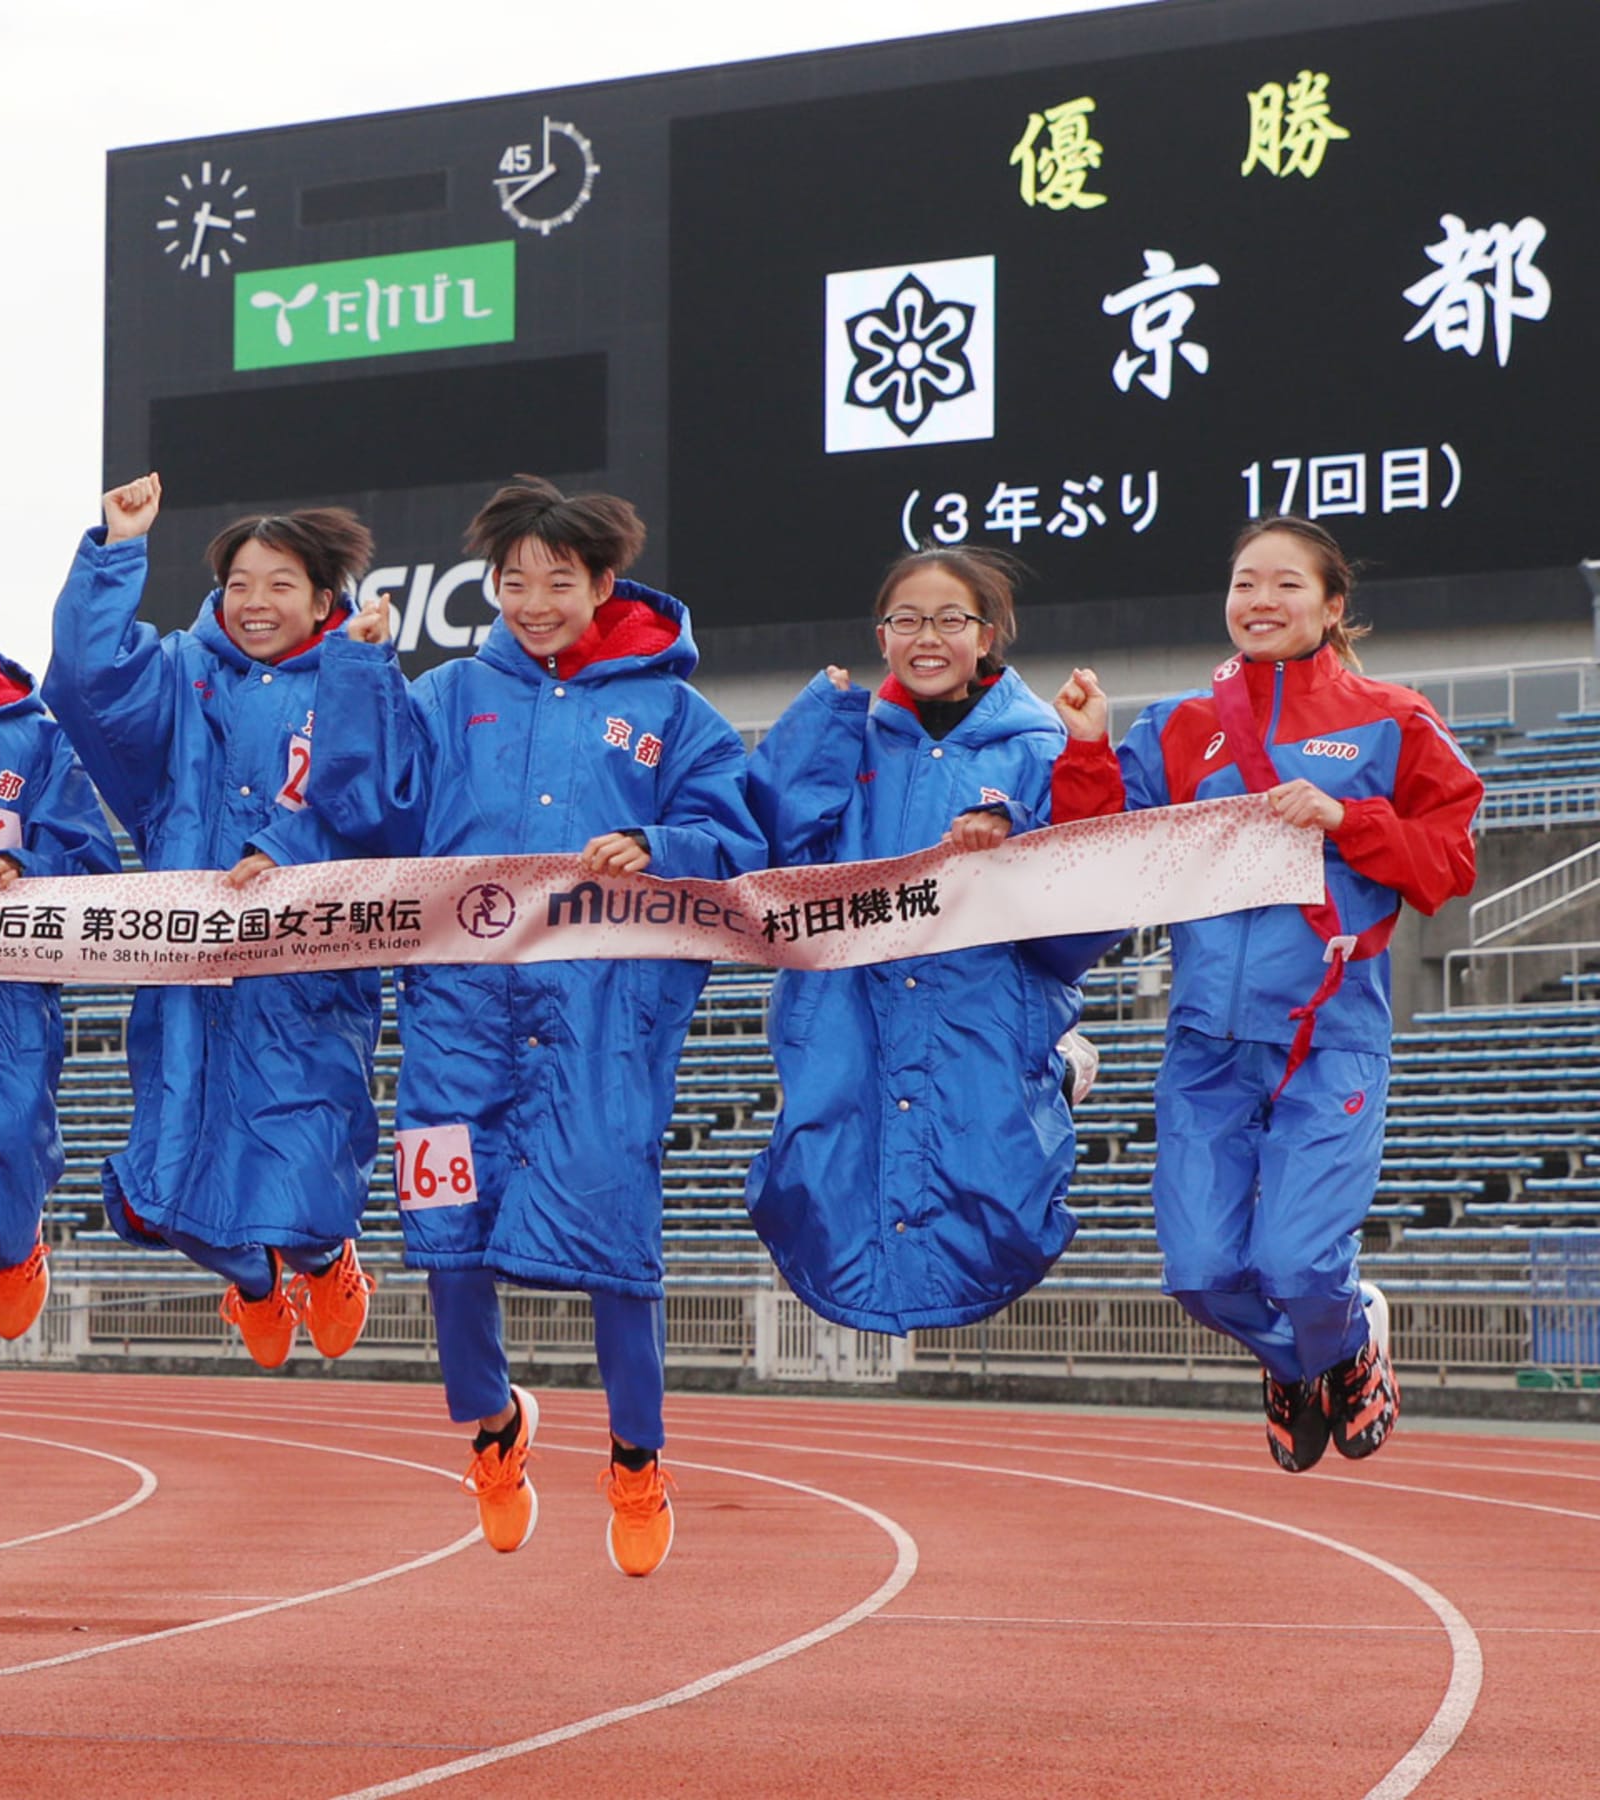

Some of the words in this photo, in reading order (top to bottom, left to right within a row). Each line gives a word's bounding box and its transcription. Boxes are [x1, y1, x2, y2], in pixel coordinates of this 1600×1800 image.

[499, 144, 532, 173] 45
[1009, 70, 1350, 211] 優勝
[324, 273, 493, 341] たけびし
[1102, 213, 1551, 399] 京都
[345, 559, 508, 651] SIC
[603, 717, 663, 768] 京都
[1303, 740, 1361, 760] KYOTO
[81, 900, 422, 943] 第38回全国女子駅伝
[761, 879, 941, 944] 村田機械
[34, 947, 64, 961] Cup
[80, 947, 107, 962] The
[112, 947, 150, 963] 38th
[153, 946, 285, 964] Inter-Prefectural
[291, 940, 362, 956] Women's
[368, 935, 421, 951] Ekiden
[395, 1139, 472, 1200] 26-8
